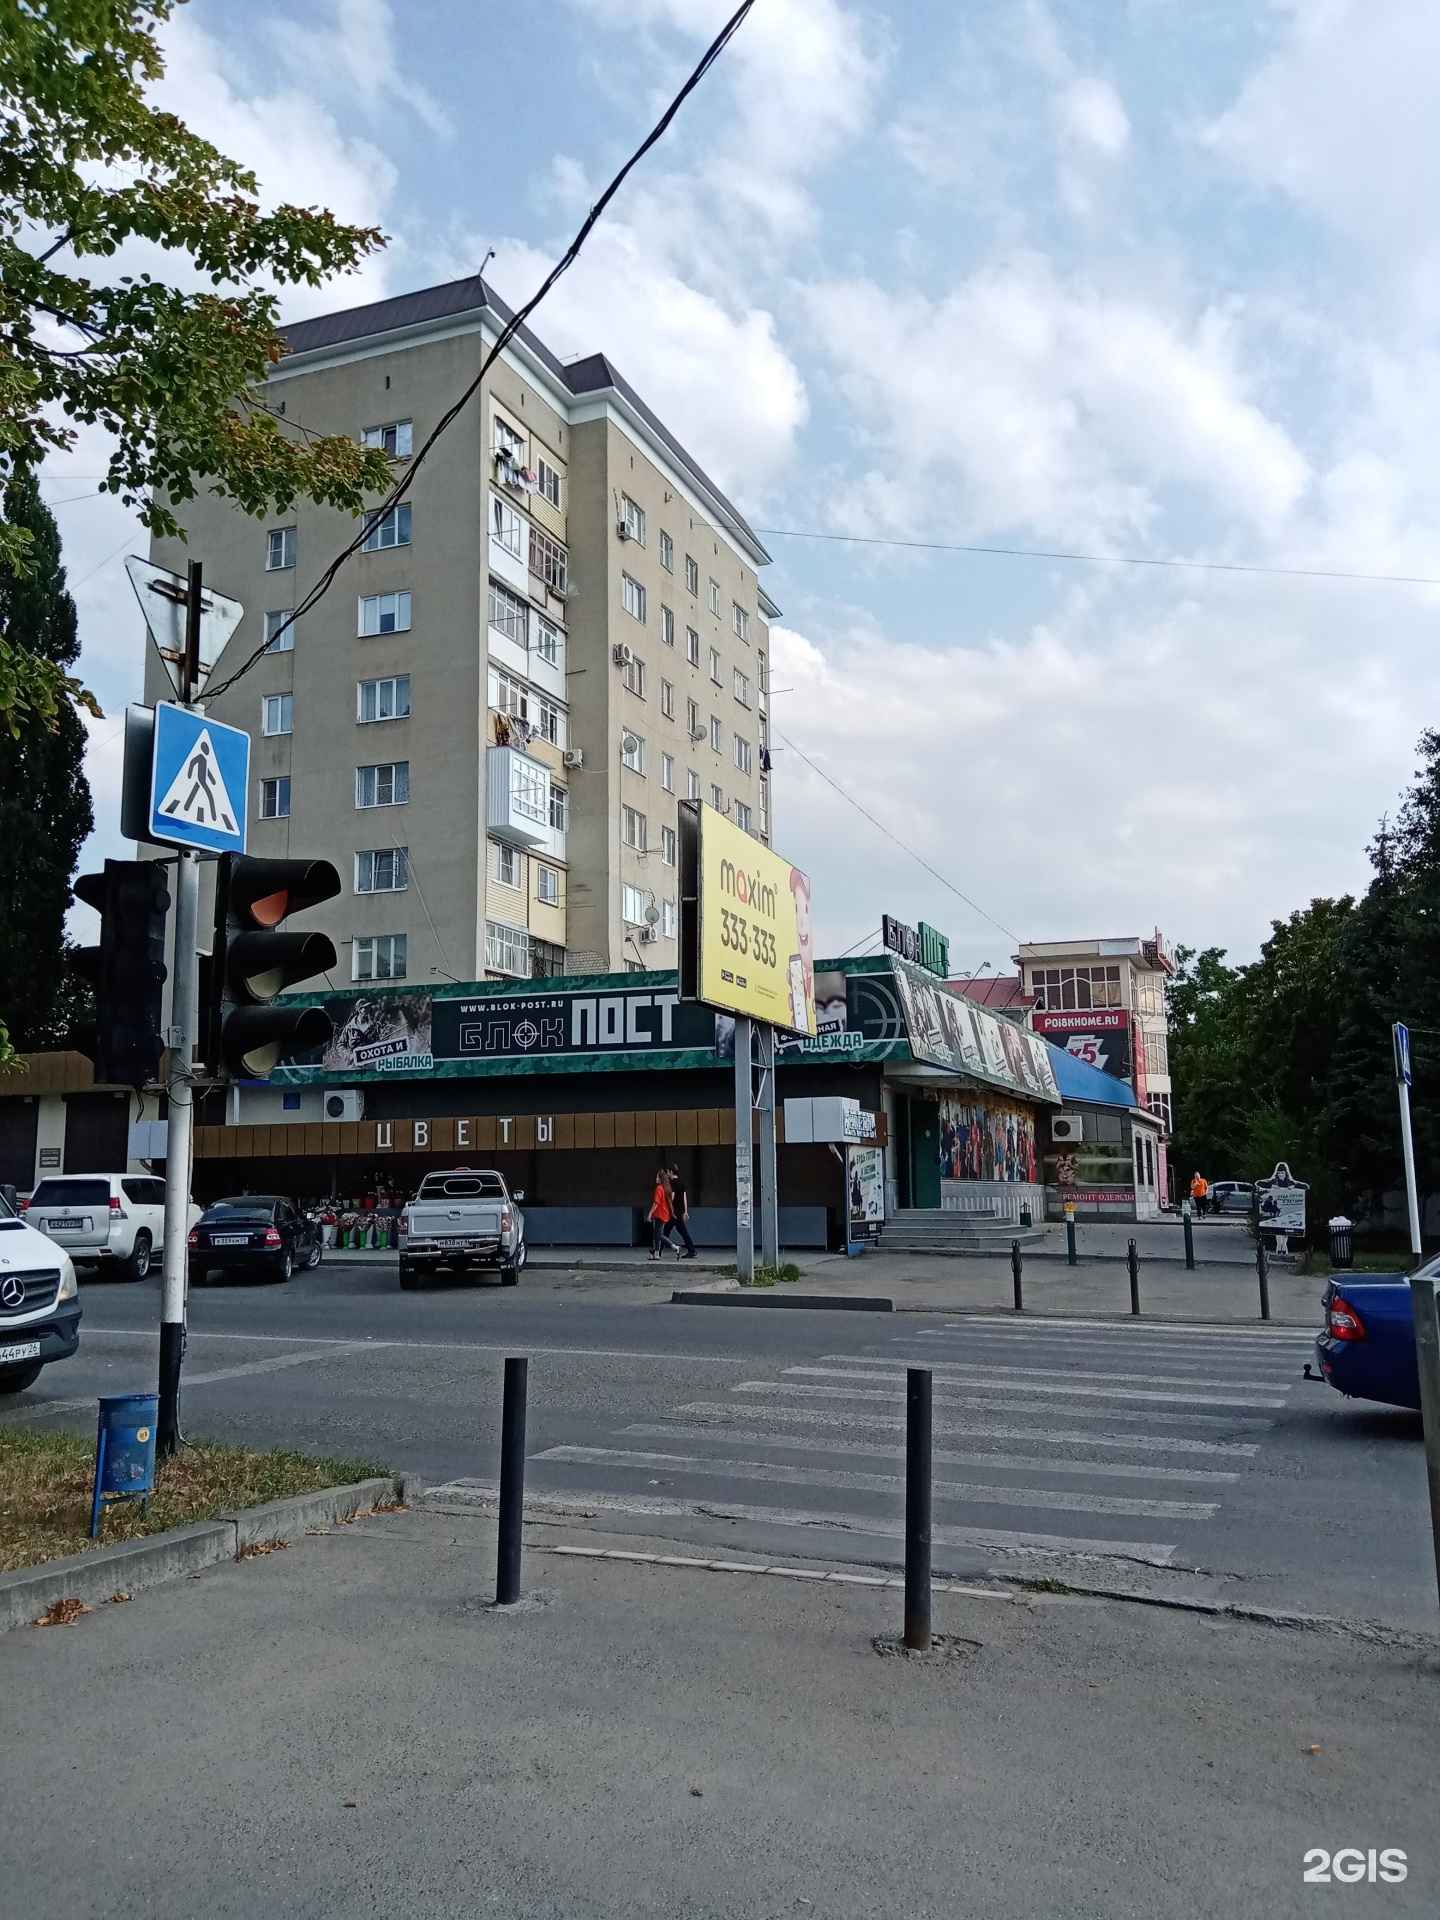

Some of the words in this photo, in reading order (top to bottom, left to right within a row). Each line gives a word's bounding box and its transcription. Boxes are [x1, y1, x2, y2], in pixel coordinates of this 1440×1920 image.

[720, 858, 776, 920] maxim
[460, 1000, 564, 1013] WWW.BLOK-POST.RU
[571, 994, 680, 1046] ПОСТ
[361, 1045, 394, 1060] ОХОТА
[395, 1042, 404, 1051] И
[379, 1055, 432, 1070] РЫБАЛКА
[377, 1117, 553, 1148] ЦВЕТЫ
[1062, 1193, 1096, 1201] РЕМОНТ
